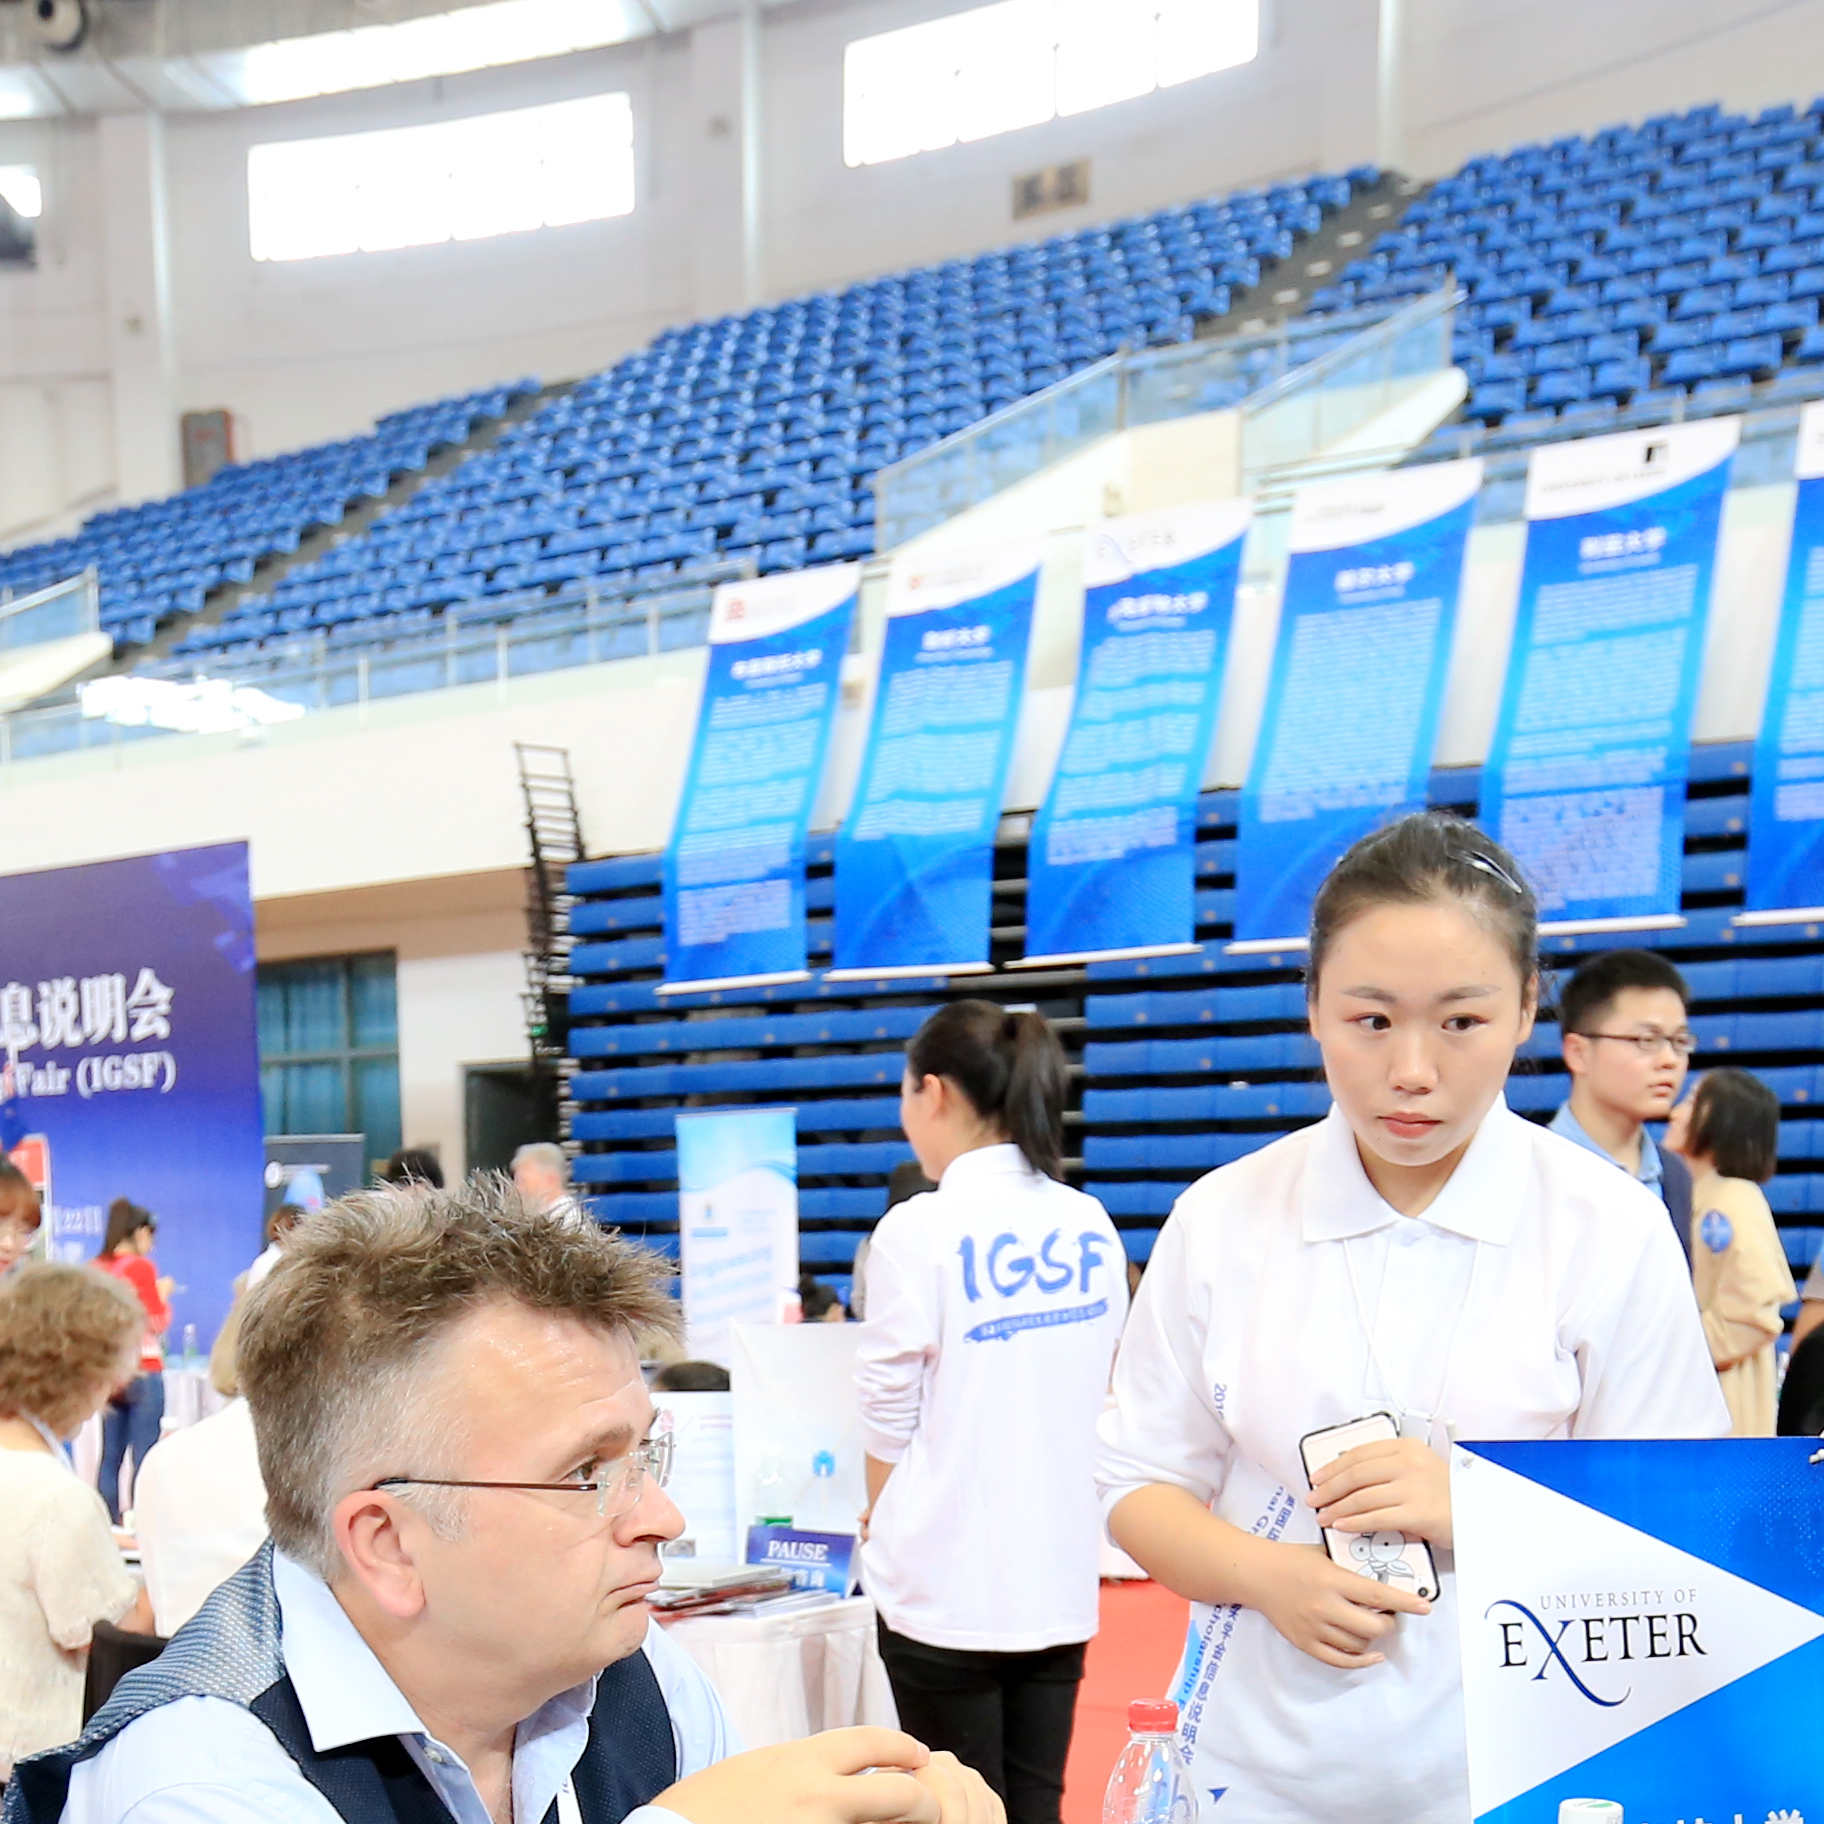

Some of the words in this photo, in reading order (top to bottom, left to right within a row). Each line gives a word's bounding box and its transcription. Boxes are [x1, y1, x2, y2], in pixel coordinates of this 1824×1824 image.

[13, 1061, 71, 1098] Fair
[76, 1052, 177, 1099] (IGSF)
[956, 1228, 1112, 1303] IGSF
[767, 1540, 829, 1561] PAUSE
[1540, 1590, 1665, 1610] UNIVERSITY
[1674, 1588, 1697, 1604] OF
[1184, 1604, 1223, 1695] cholarship
[1484, 1599, 1708, 1707] EXETER
